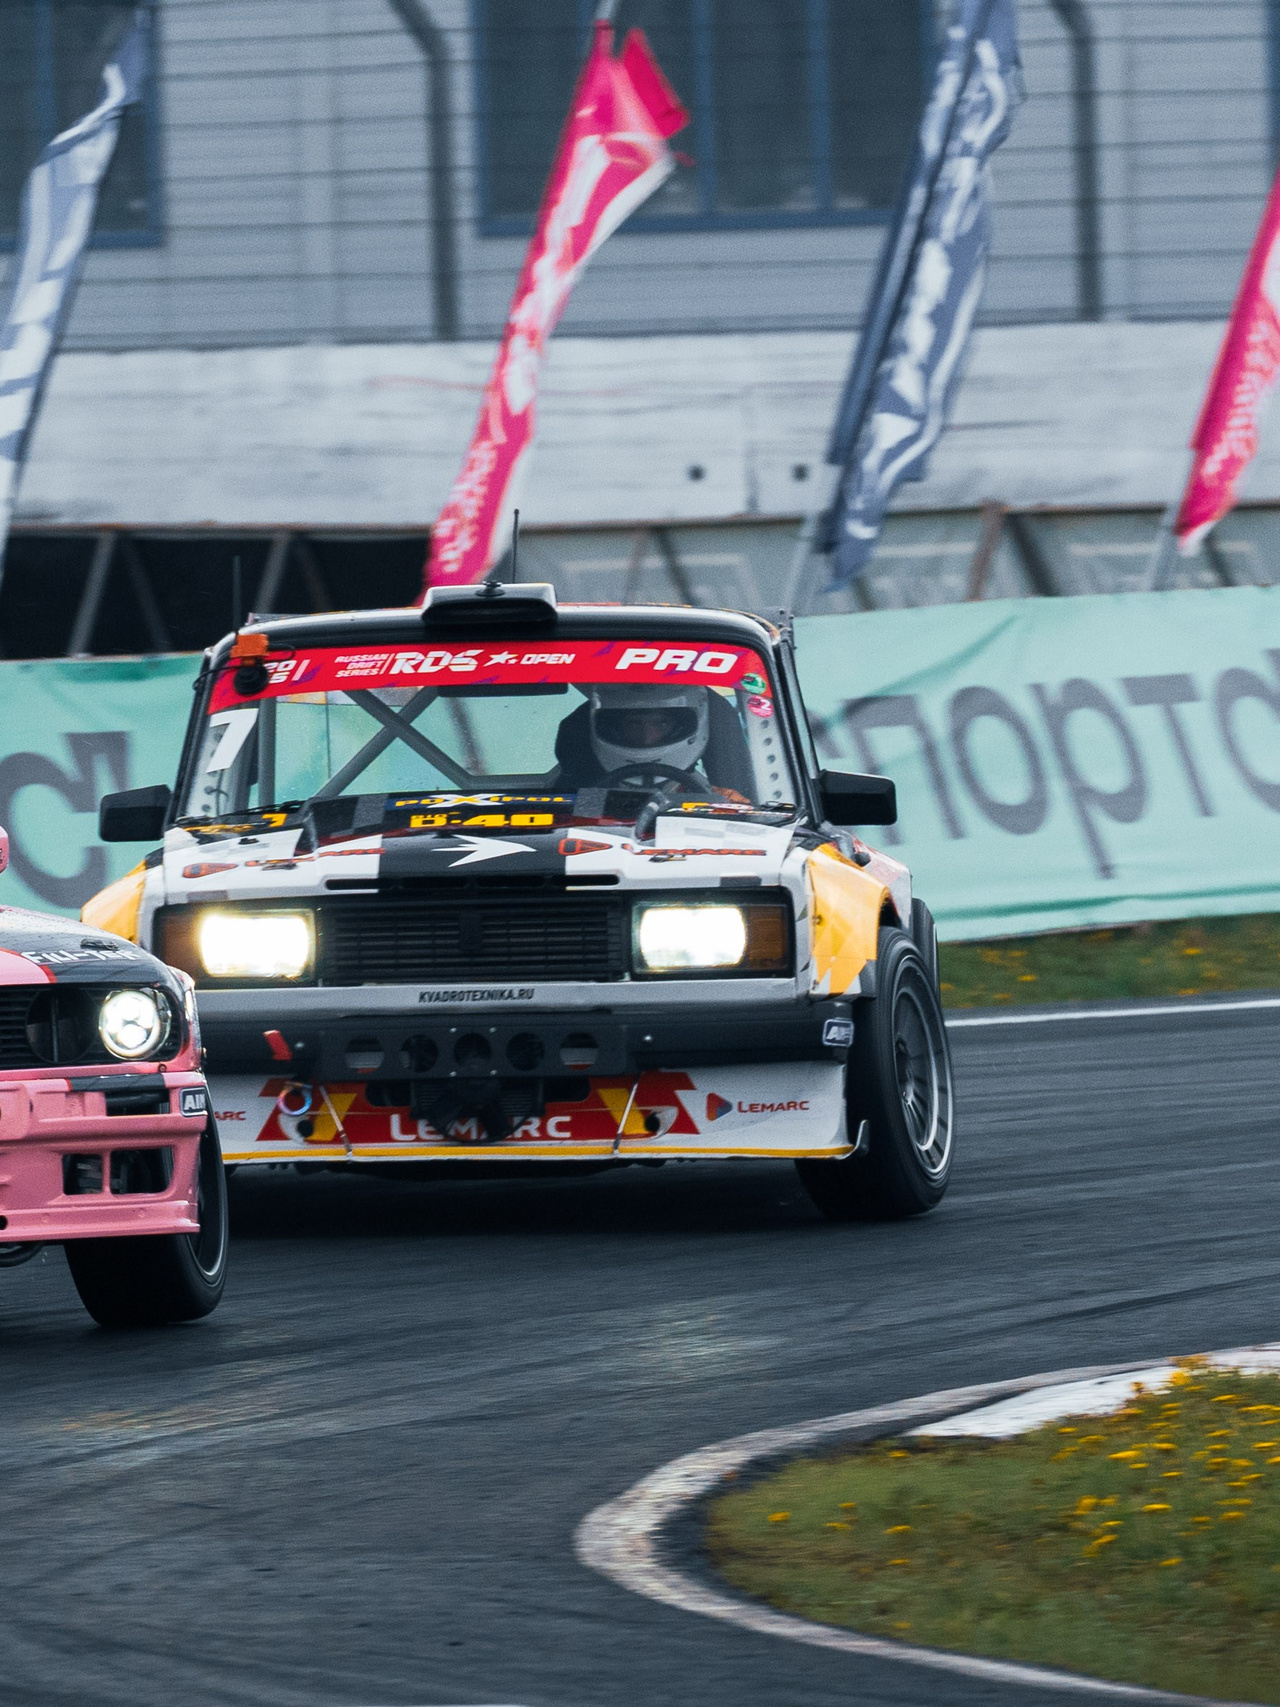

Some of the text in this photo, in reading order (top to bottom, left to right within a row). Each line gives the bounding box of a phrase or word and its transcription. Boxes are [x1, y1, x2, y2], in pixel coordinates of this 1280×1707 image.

[335, 653, 389, 664] RUSSIAN
[389, 648, 738, 675] RDS OPEN PRO
[347, 661, 385, 670] DRIFT
[335, 668, 380, 678] SERIES
[760, 699, 771, 711] 2
[395, 793, 572, 808] POXIPOL
[736, 1099, 811, 1115] LEMARC
